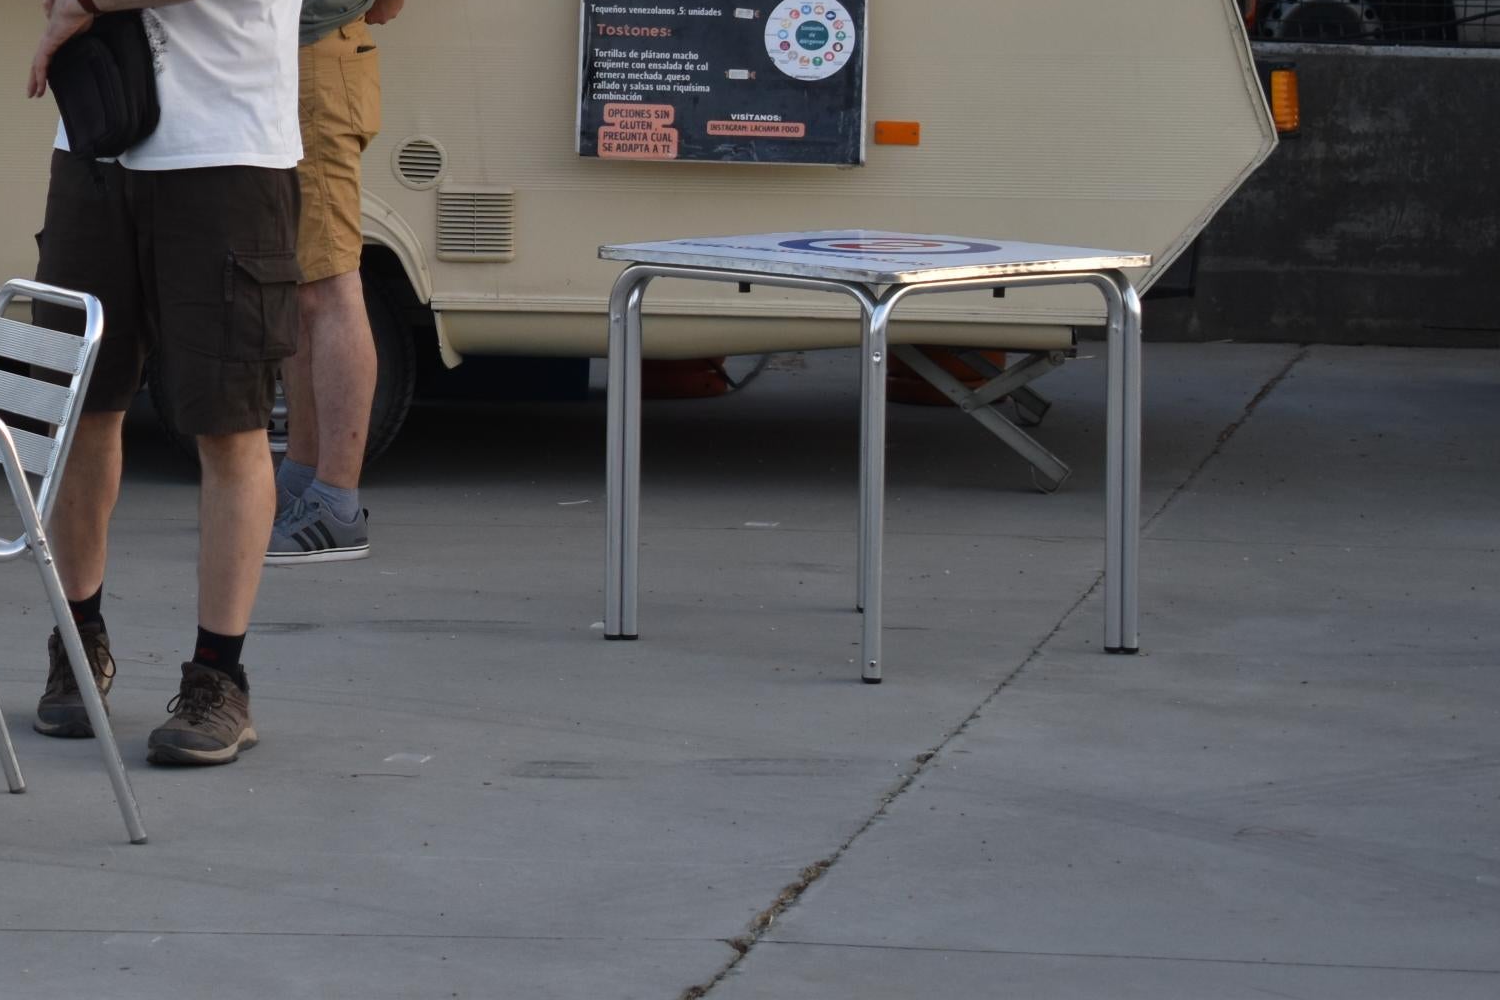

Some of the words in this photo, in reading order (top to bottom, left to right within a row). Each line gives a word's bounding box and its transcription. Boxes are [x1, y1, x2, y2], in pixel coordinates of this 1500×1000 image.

[590, 4, 627, 15] Tequeños
[629, 6, 675, 16] venezolanos
[688, 7, 722, 17] unidades
[596, 23, 672, 37] Tostones:
[594, 48, 627, 58] Tortillas
[628, 49, 639, 59] de
[640, 49, 671, 60] plátano
[672, 51, 699, 60] macho
[593, 60, 629, 70] crujiente
[647, 61, 682, 71] ensalada
[684, 62, 695, 71] de
[696, 62, 709, 71] col
[627, 71, 662, 81] mechada
[592, 81, 620, 90] rallado
[622, 83, 628, 91] y
[629, 82, 654, 91] salsas
[672, 83, 710, 94] riquísima
[592, 91, 642, 101] combinación
[607, 108, 652, 119] OPCIONES
[654, 109, 670, 119] SIN
[619, 120, 653, 130] GLUTEN
[710, 123, 749, 132] INSTAGRAM:
[603, 131, 648, 141] PREGUNTA
[650, 132, 672, 142] CUAL
[602, 143, 613, 152] SE
[615, 143, 650, 153] ADAPTA
[652, 144, 659, 153] A
